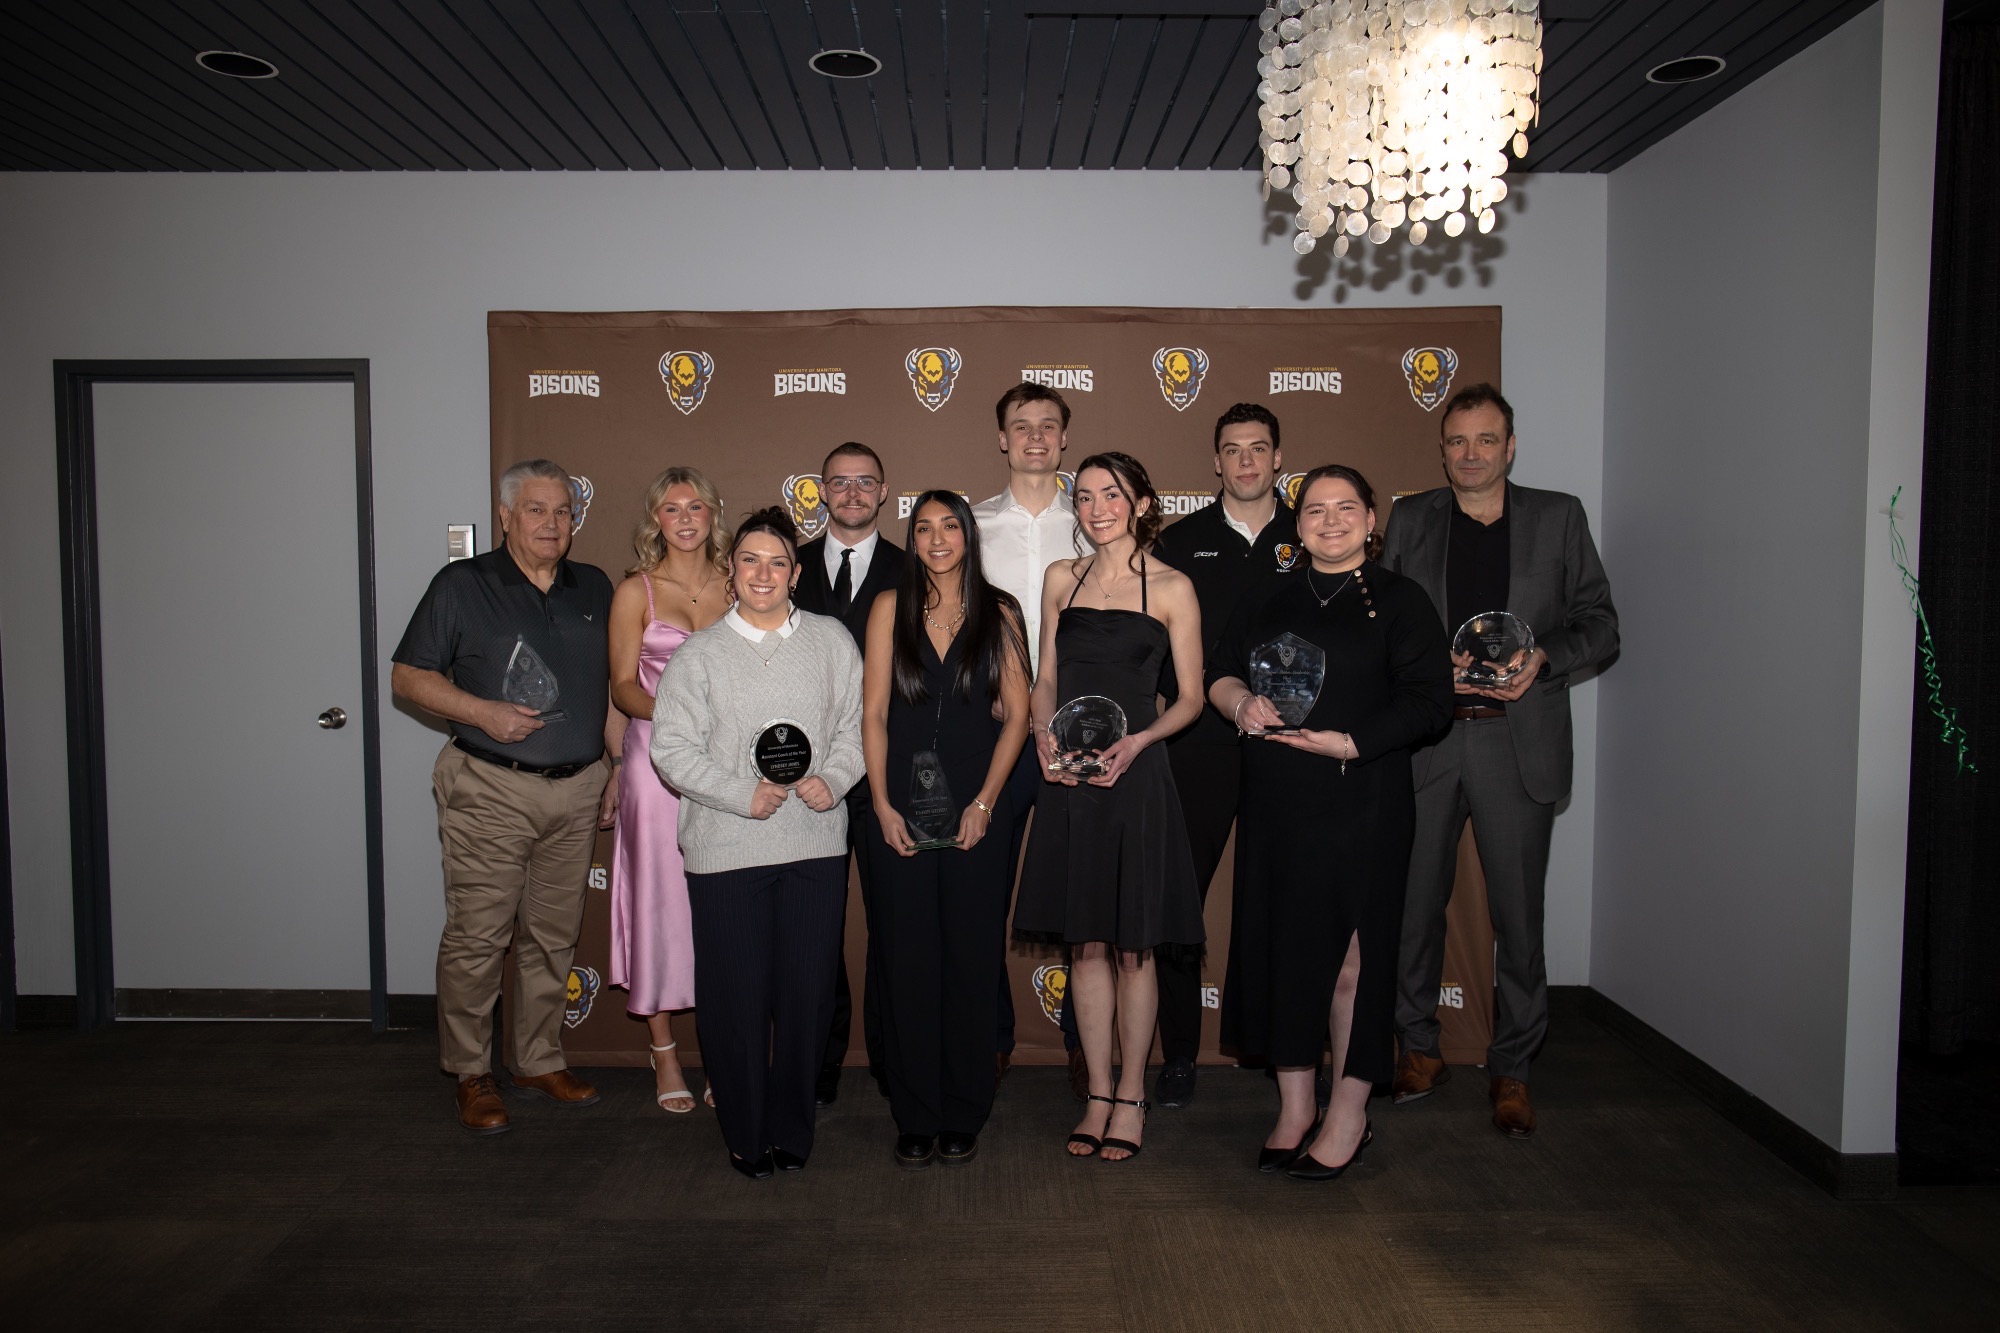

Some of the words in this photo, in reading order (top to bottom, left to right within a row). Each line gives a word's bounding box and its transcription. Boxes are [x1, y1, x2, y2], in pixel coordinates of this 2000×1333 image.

[528, 374, 600, 398] BISONS
[774, 372, 846, 397] BISONS
[1021, 369, 1094, 392] BISONS
[1268, 371, 1342, 395] BISONS
